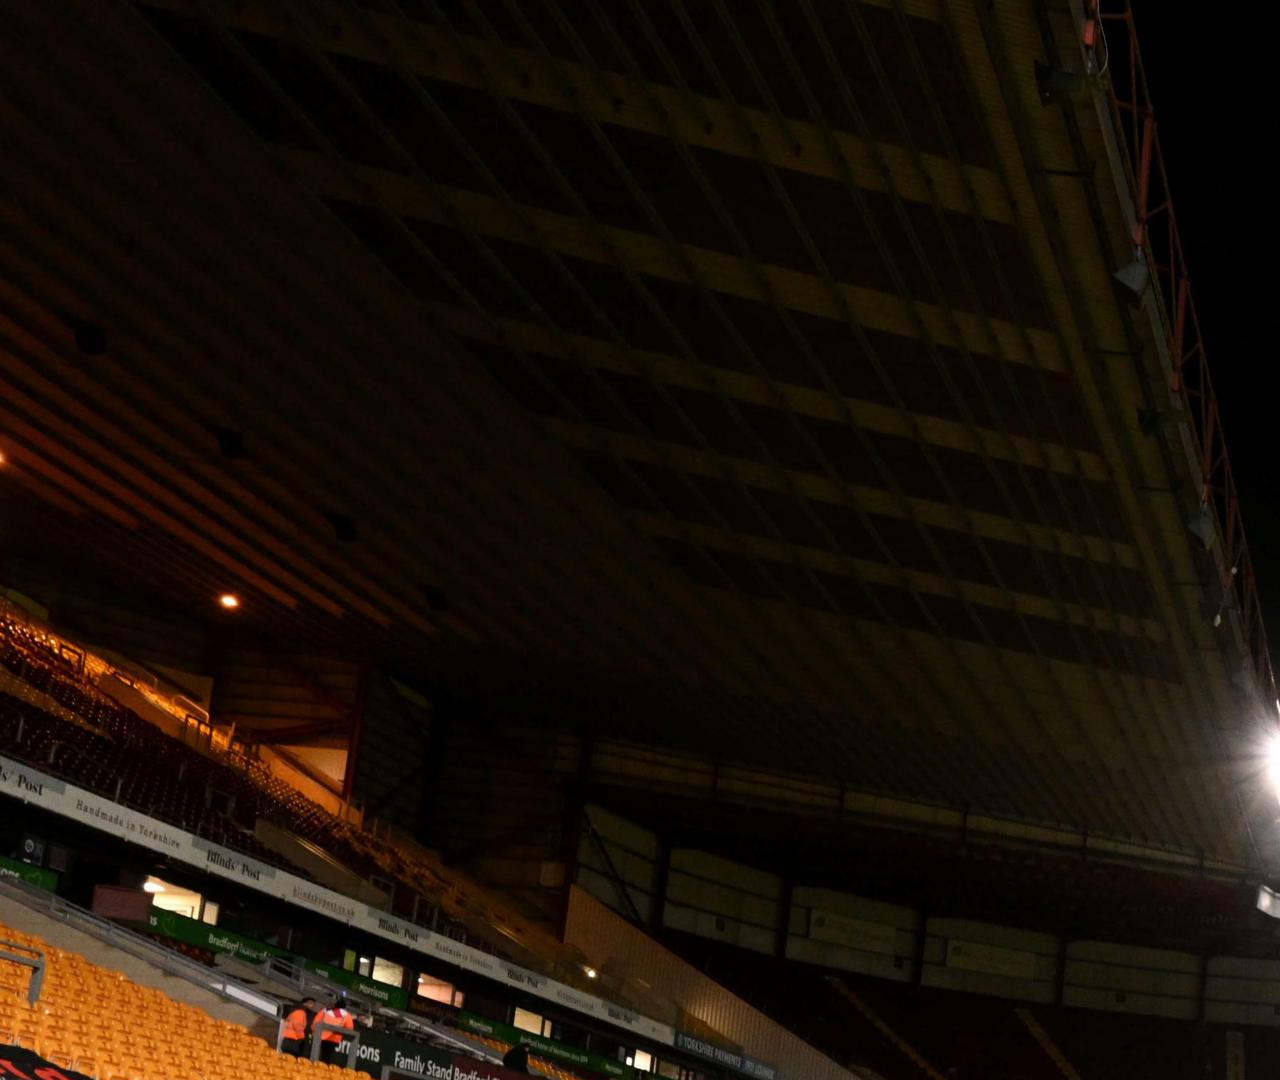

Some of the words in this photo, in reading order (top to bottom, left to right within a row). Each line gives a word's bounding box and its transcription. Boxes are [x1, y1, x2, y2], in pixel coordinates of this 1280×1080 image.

[17, 773, 44, 796] Post
[76, 799, 124, 828] Handmade
[206, 850, 235, 871] Blinds
[241, 863, 261, 881] Post
[378, 918, 400, 935] Blinds
[404, 927, 418, 942] Post
[395, 1052, 424, 1074] Family
[426, 1059, 452, 1080] Stand
[684, 1037, 714, 1057] YORKSHIRE
[715, 1047, 741, 1068] PAYMENTS
